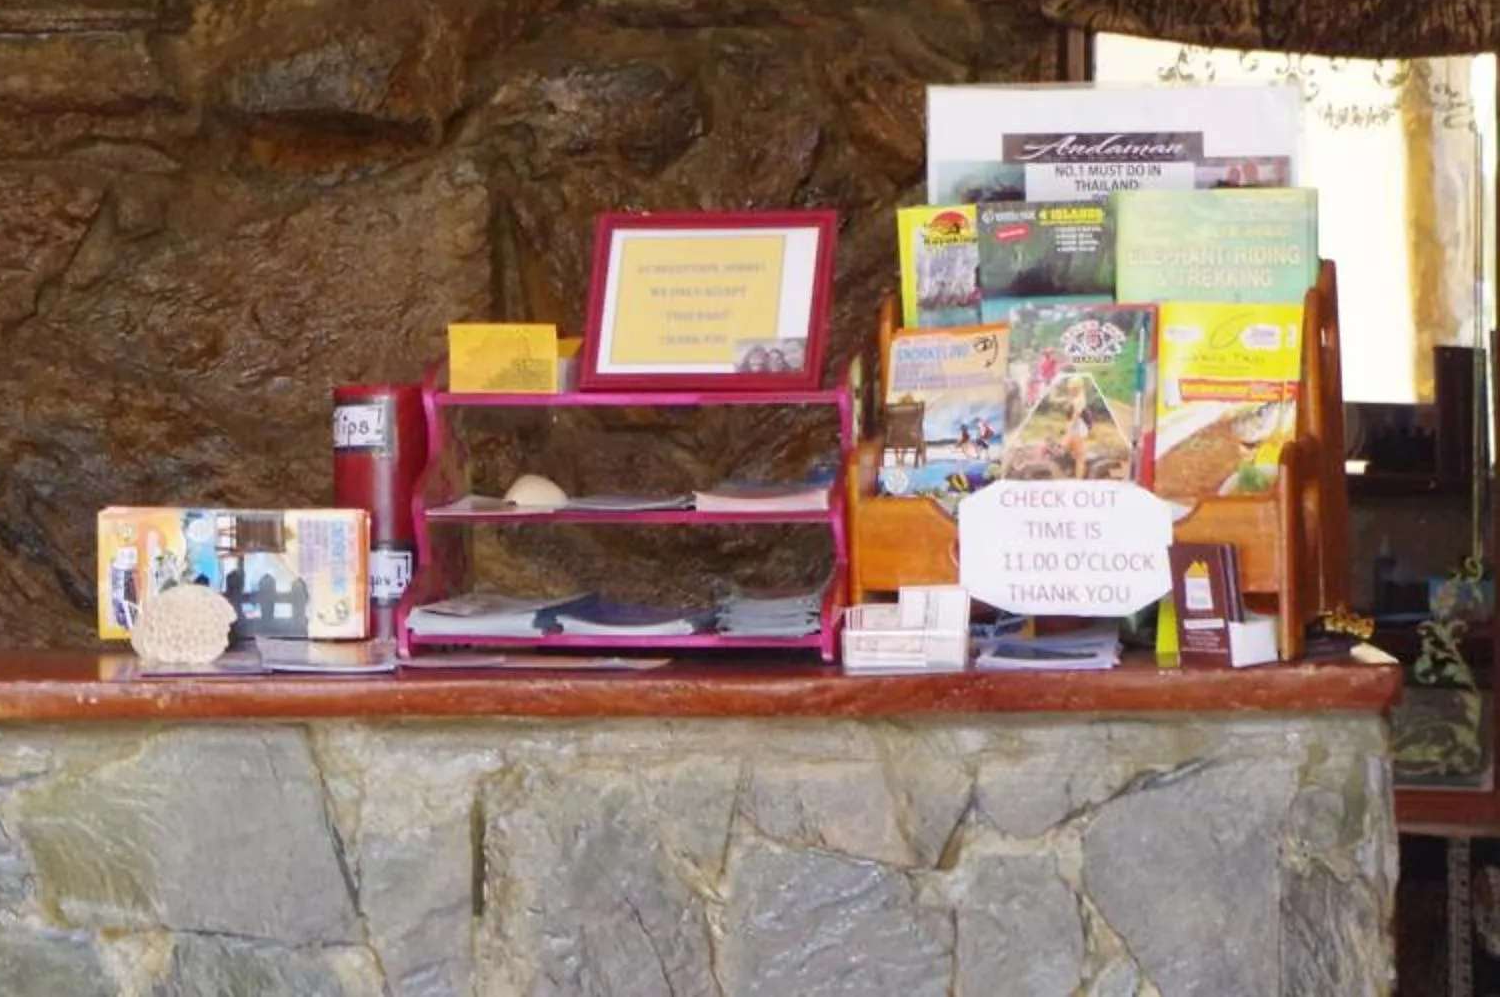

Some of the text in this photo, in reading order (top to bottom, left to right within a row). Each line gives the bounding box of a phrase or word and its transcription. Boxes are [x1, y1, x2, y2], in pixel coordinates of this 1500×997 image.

[1019, 133, 1186, 161] Andaman
[1087, 164, 1123, 177] MUST
[1126, 164, 1145, 177] DO
[1148, 164, 1162, 177] IN
[1074, 178, 1140, 192] THAILAND
[1127, 245, 1302, 268] ELEPHANT RIDING
[1177, 267, 1274, 289] TREKKING
[999, 489, 1118, 509] CHECK OUT
[1027, 521, 1103, 540] TIME IS
[1003, 552, 1156, 572] 11.00 O'CLOCK
[1009, 585, 1132, 603] THANK YOU
